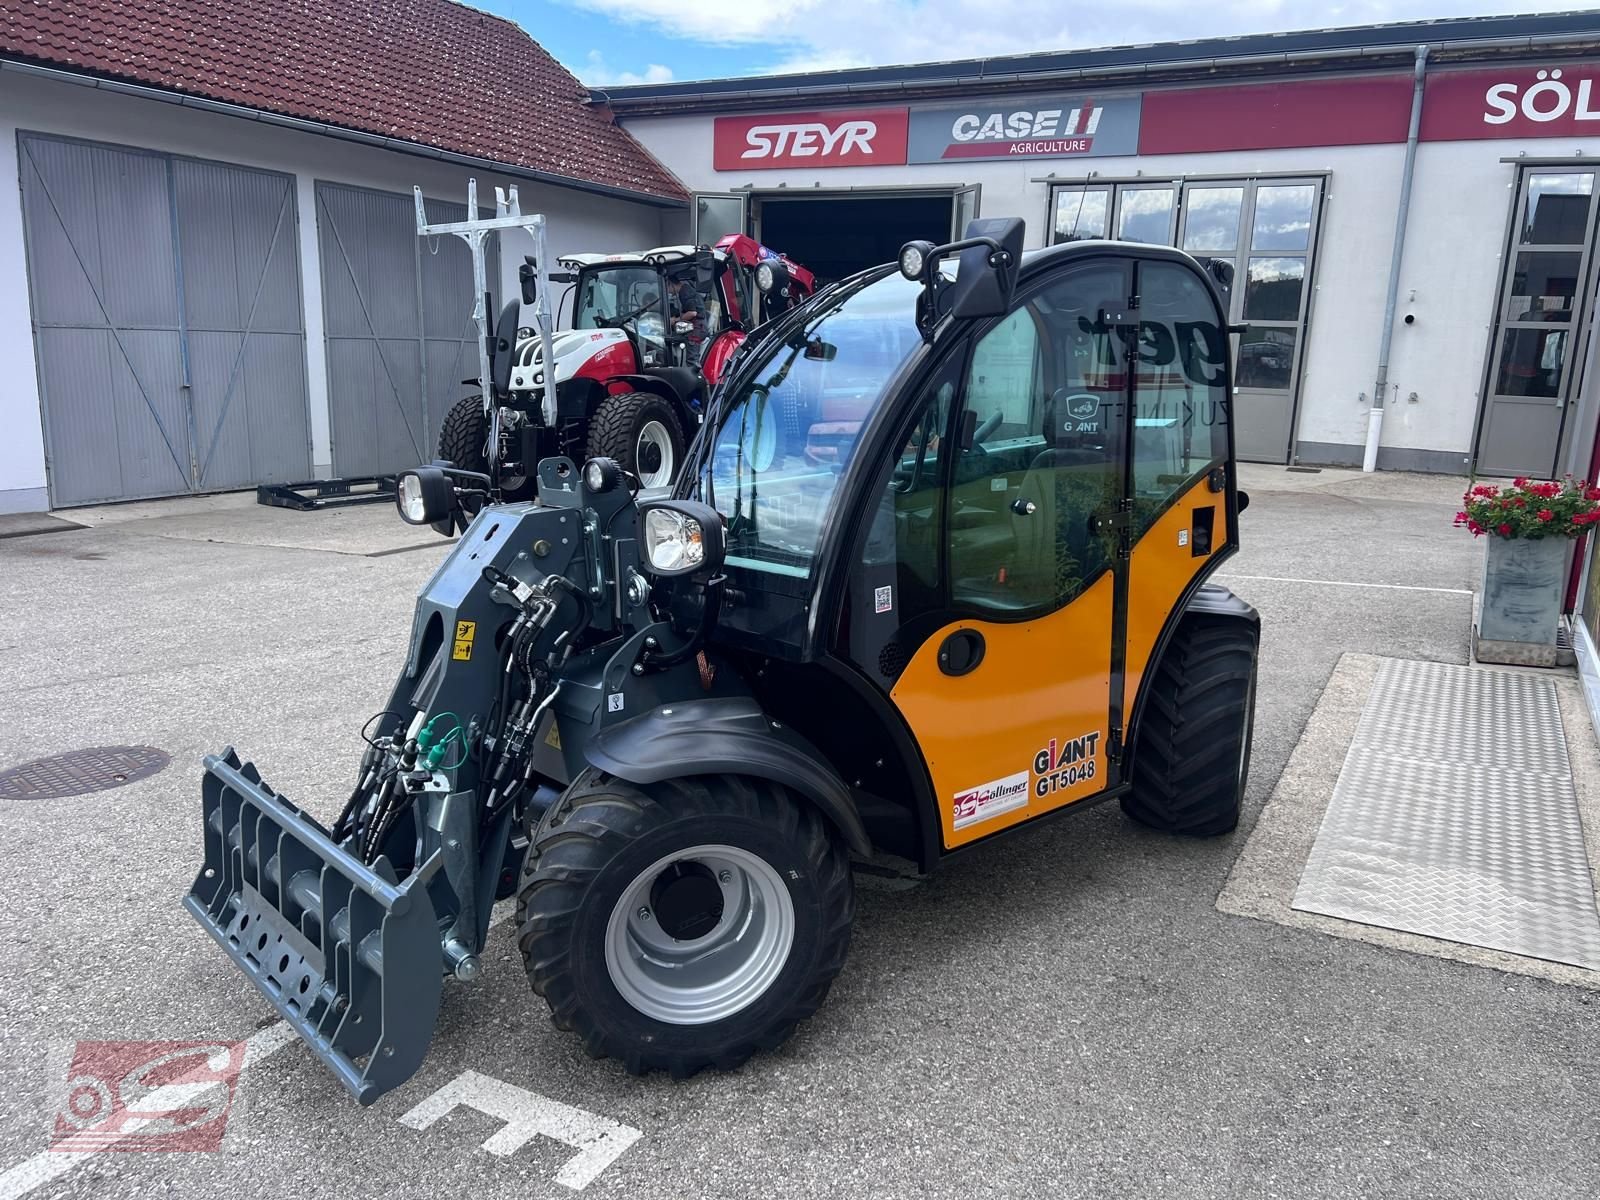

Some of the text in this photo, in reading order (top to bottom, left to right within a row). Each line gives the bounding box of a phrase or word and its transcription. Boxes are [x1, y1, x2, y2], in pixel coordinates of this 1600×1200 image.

[1483, 68, 1600, 124] SÖL
[741, 121, 877, 158] STEYR
[952, 112, 1061, 142] CASE
[1009, 140, 1086, 153] AGRICULTURE
[978, 780, 1028, 807] Söllinger
[1036, 760, 1095, 798] GT5048
